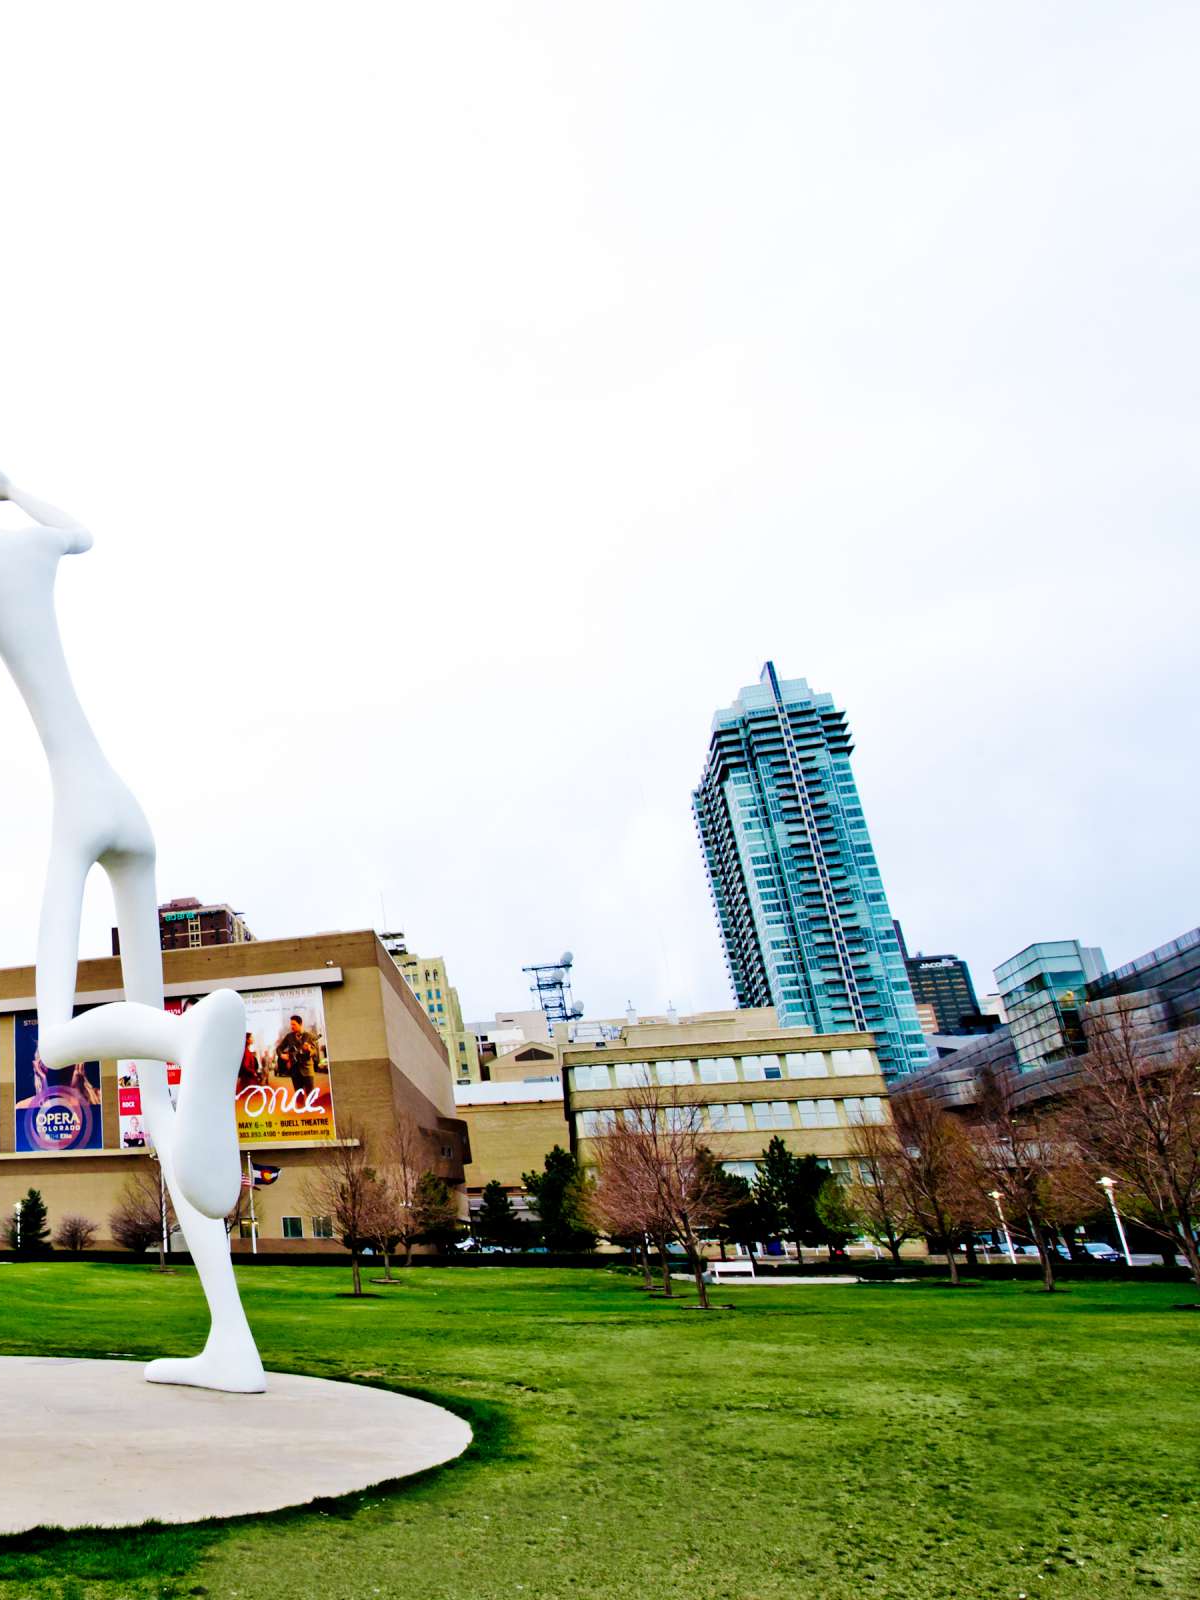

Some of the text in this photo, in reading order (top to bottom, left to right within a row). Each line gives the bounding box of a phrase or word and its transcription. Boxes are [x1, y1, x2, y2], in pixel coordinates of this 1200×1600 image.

[36, 1112, 80, 1126] OPERA
[239, 1121, 252, 1129] MAY
[280, 1119, 299, 1127] BUELL
[301, 1118, 329, 1126] THEATRE
